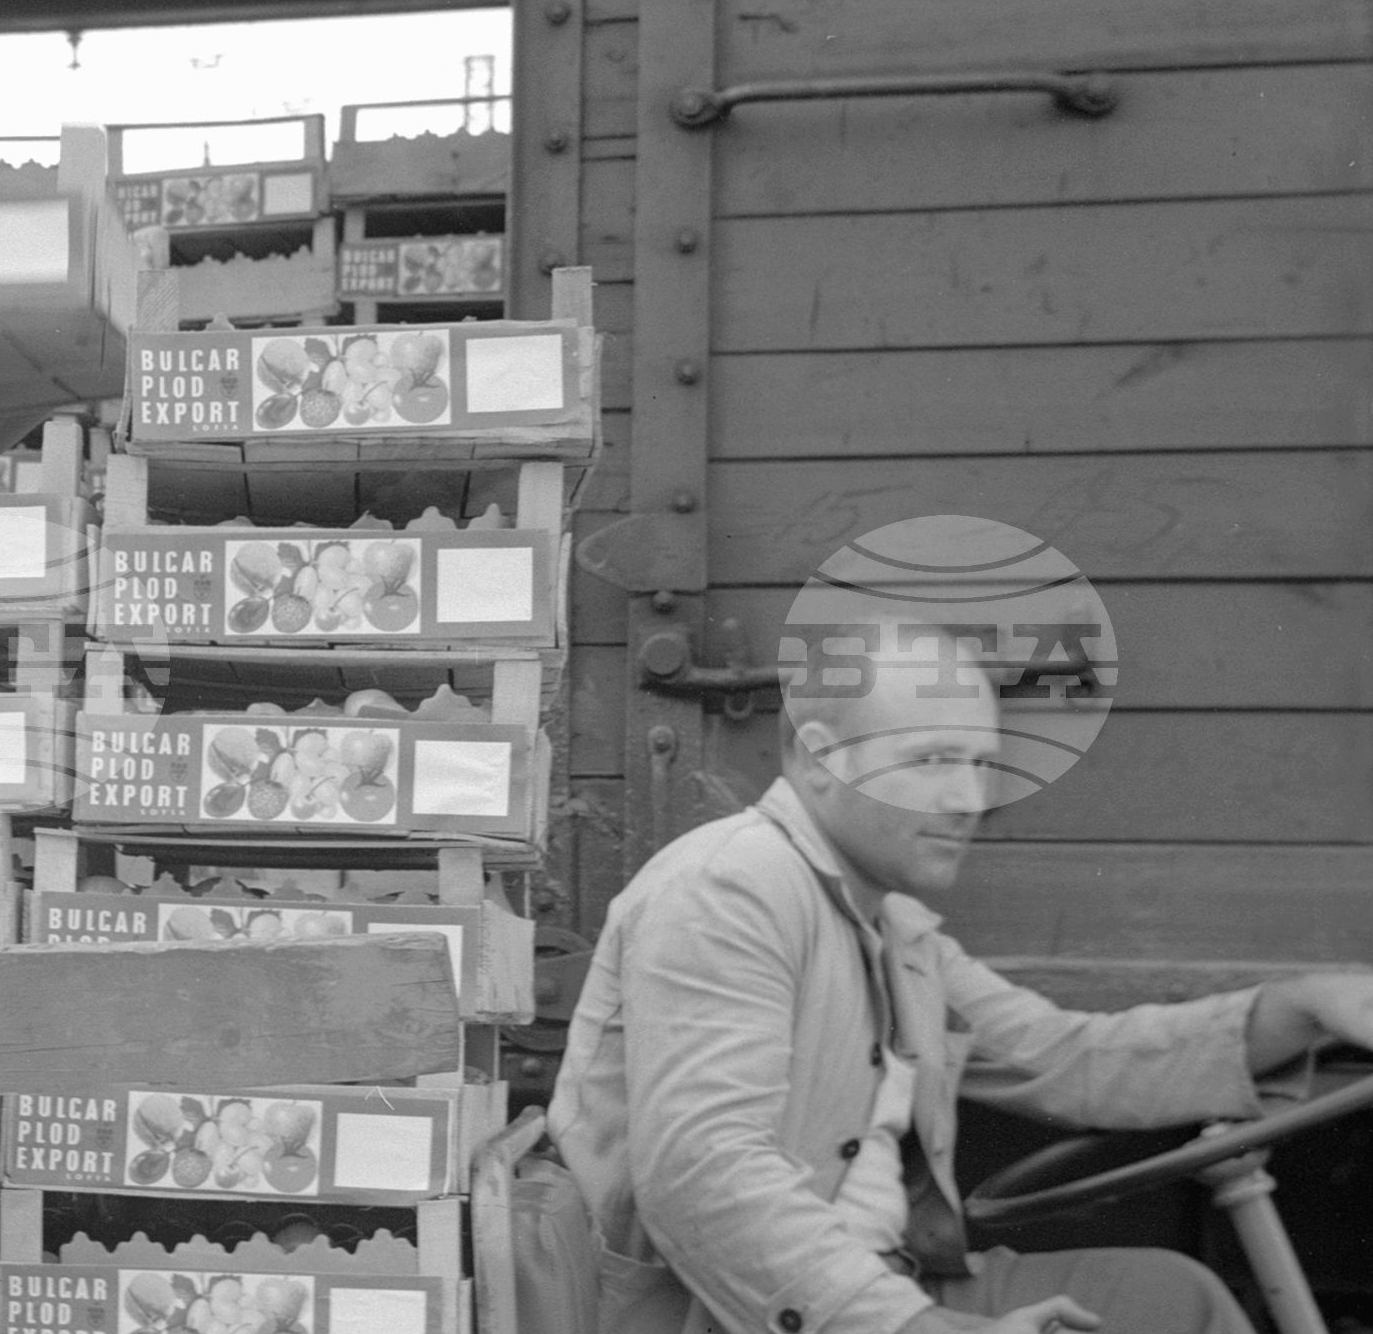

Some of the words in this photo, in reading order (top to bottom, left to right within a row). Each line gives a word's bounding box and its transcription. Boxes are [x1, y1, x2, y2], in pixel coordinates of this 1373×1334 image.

[141, 375, 204, 398] PLOD
[141, 401, 240, 424] EXPORT
[114, 577, 177, 600] PLOD
[114, 603, 212, 625] EXPORT
[90, 757, 154, 780] PLOD
[90, 783, 188, 807] EXPORT
[18, 1122, 81, 1145] PLOD
[17, 1146, 114, 1174] EXPORT
[8, 1301, 72, 1325] PLOD
